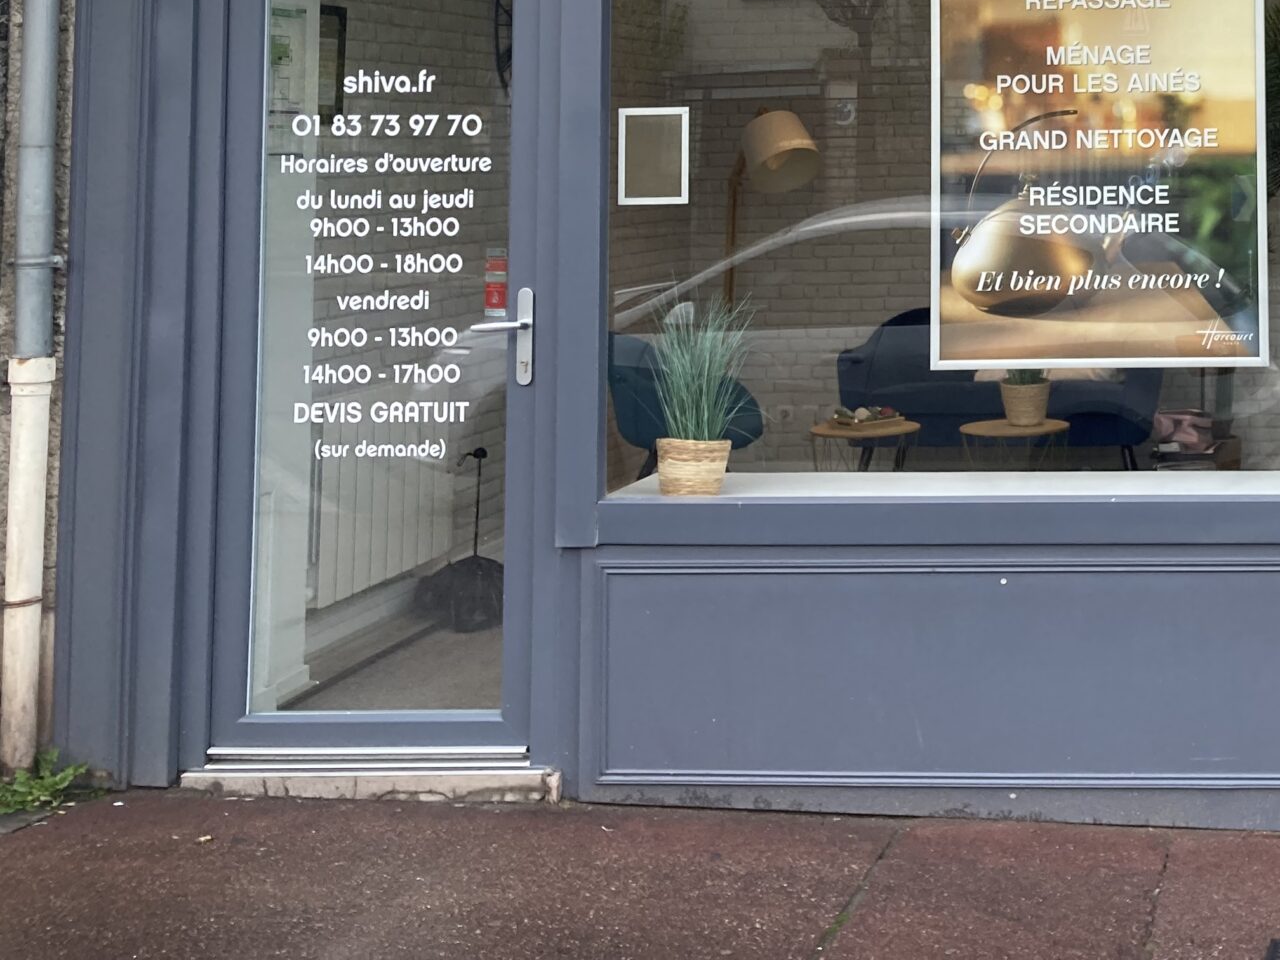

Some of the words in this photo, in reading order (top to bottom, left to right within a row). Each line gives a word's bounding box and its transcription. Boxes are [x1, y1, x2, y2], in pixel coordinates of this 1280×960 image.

[1046, 41, 1151, 66] MÉNAGE
[343, 70, 436, 94] shiva.fr
[996, 74, 1064, 94] POUR
[1073, 73, 1118, 93] LES
[1127, 67, 1201, 93] AINÉS
[291, 115, 321, 137] 01
[331, 114, 362, 137] 83
[370, 114, 401, 137] 73
[408, 114, 438, 137] 97
[447, 114, 483, 137] 70
[979, 130, 1067, 151] GRAND
[1076, 127, 1218, 150] NETTOYAGE
[280, 154, 368, 174] Horaires
[375, 153, 492, 173] d'ouverture
[296, 189, 322, 209] du
[330, 189, 382, 210] lundi
[389, 195, 415, 209] au
[422, 189, 474, 214] jeudi
[1029, 181, 1170, 206] RÉSIDENCE
[310, 218, 369, 237] 9h00
[391, 218, 460, 237] 13h00
[1019, 213, 1180, 235] SECONDAIRE
[305, 254, 373, 274] 14h00
[395, 254, 463, 273] 18h00
[976, 270, 1003, 293] Et
[1009, 270, 1061, 291] bien
[1067, 269, 1121, 295] plus
[1127, 271, 1208, 290] encore
[1214, 268, 1224, 288] !
[336, 290, 430, 311] vendredi
[307, 328, 367, 347] 9h00
[389, 327, 458, 347] 13h00
[1195, 315, 1254, 350] Harcourt
[303, 365, 372, 384] 14h00
[393, 364, 461, 384] 17h00
[293, 402, 362, 424] DEVIS
[370, 401, 470, 423] GRATUIT
[314, 440, 349, 459] (sur
[354, 439, 446, 459] demande)
